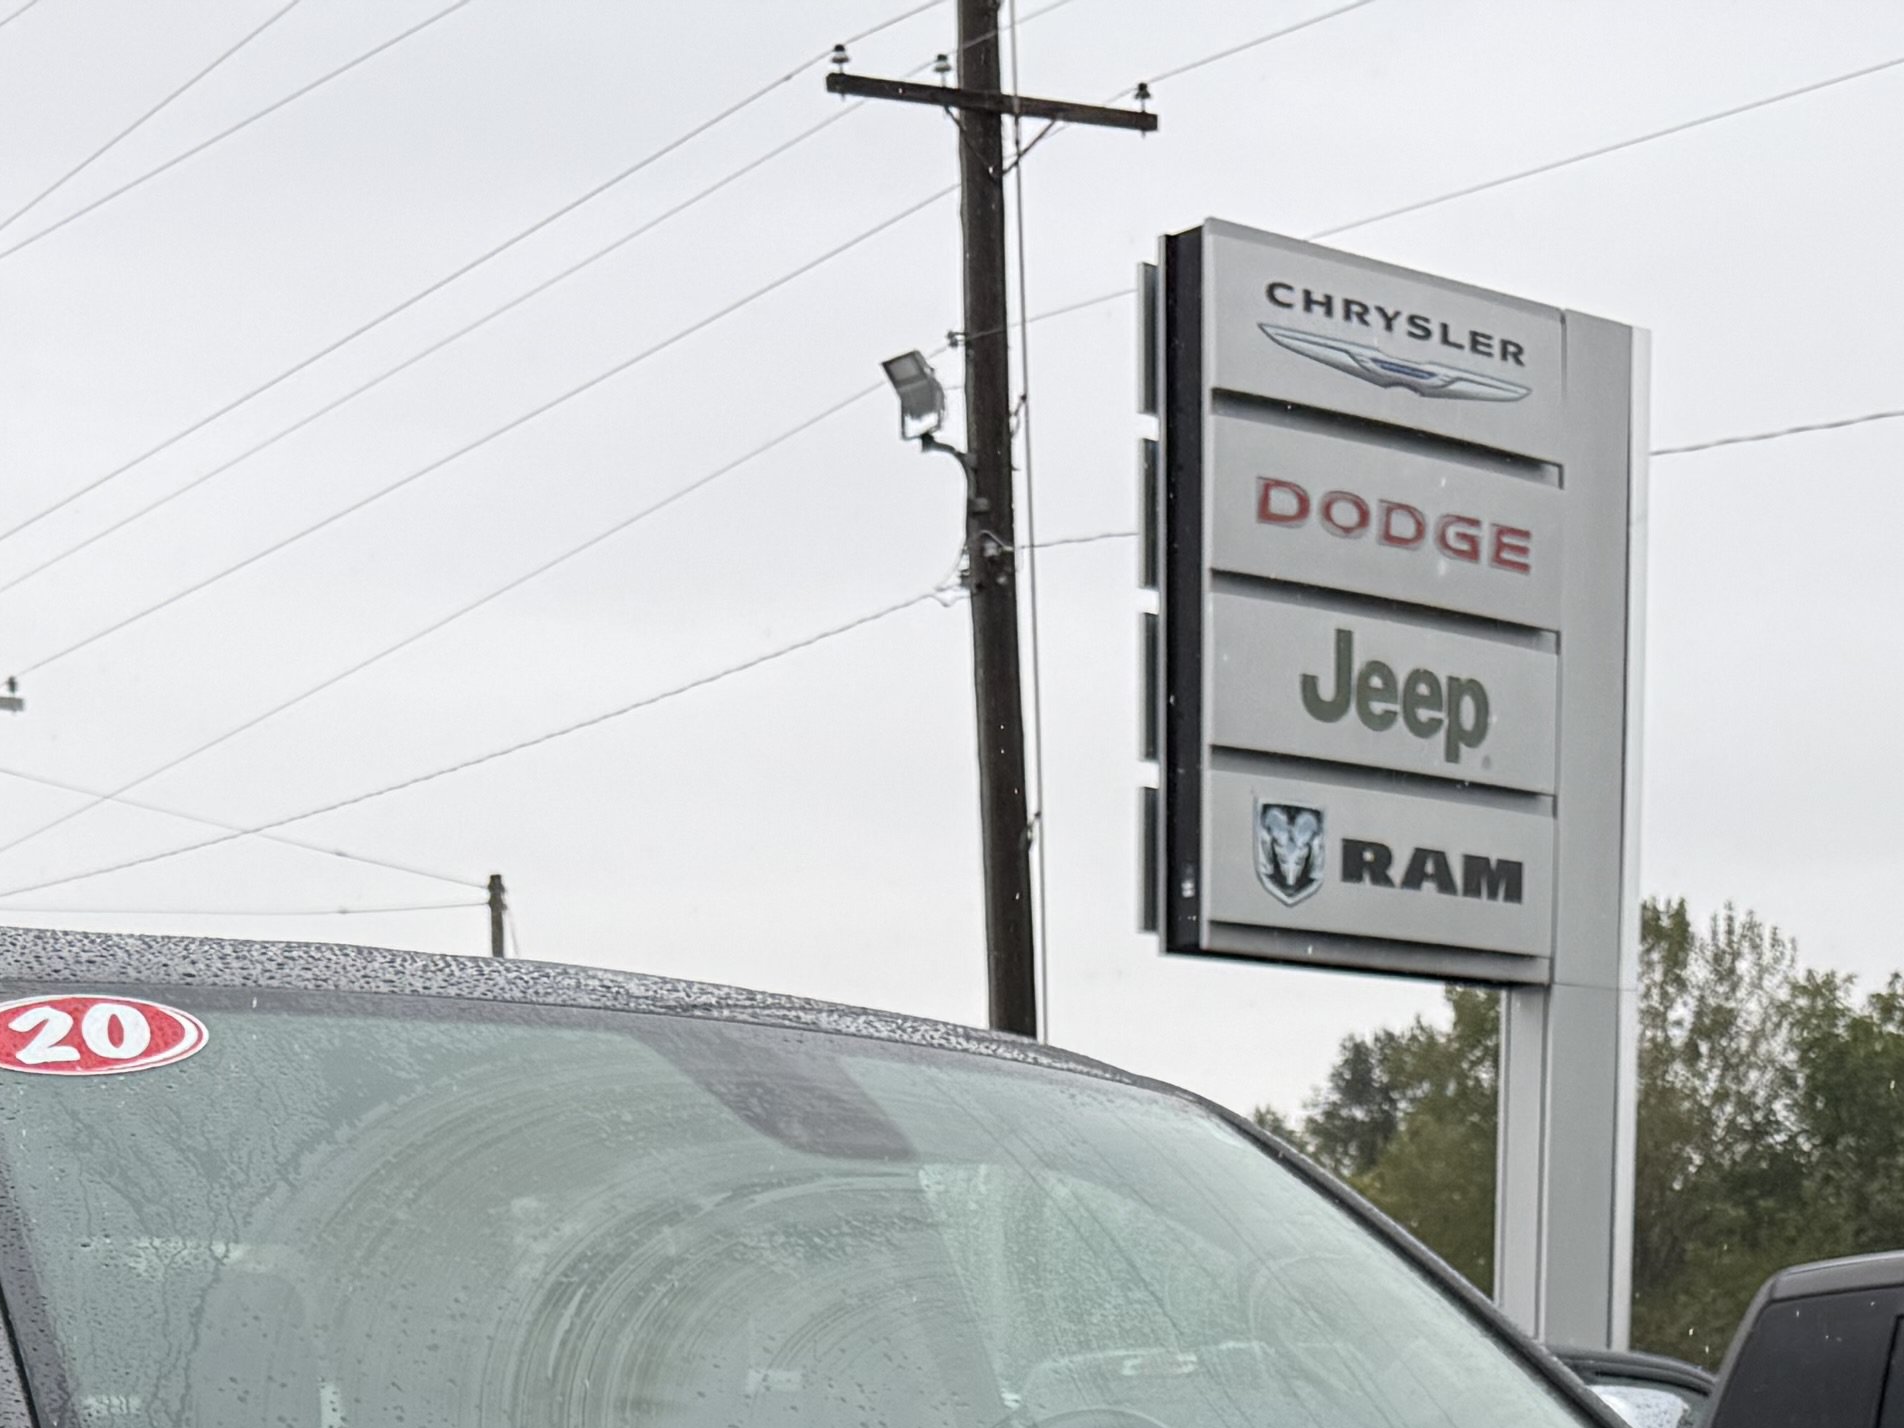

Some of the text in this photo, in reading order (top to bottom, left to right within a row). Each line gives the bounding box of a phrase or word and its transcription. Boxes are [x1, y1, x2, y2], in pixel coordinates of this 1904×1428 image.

[1266, 281, 1526, 367] CHRYSLER
[1256, 476, 1532, 574] DODGE
[1301, 629, 1490, 762] Jeep
[1341, 838, 1524, 905] RAM
[8, 1003, 151, 1064] 20
